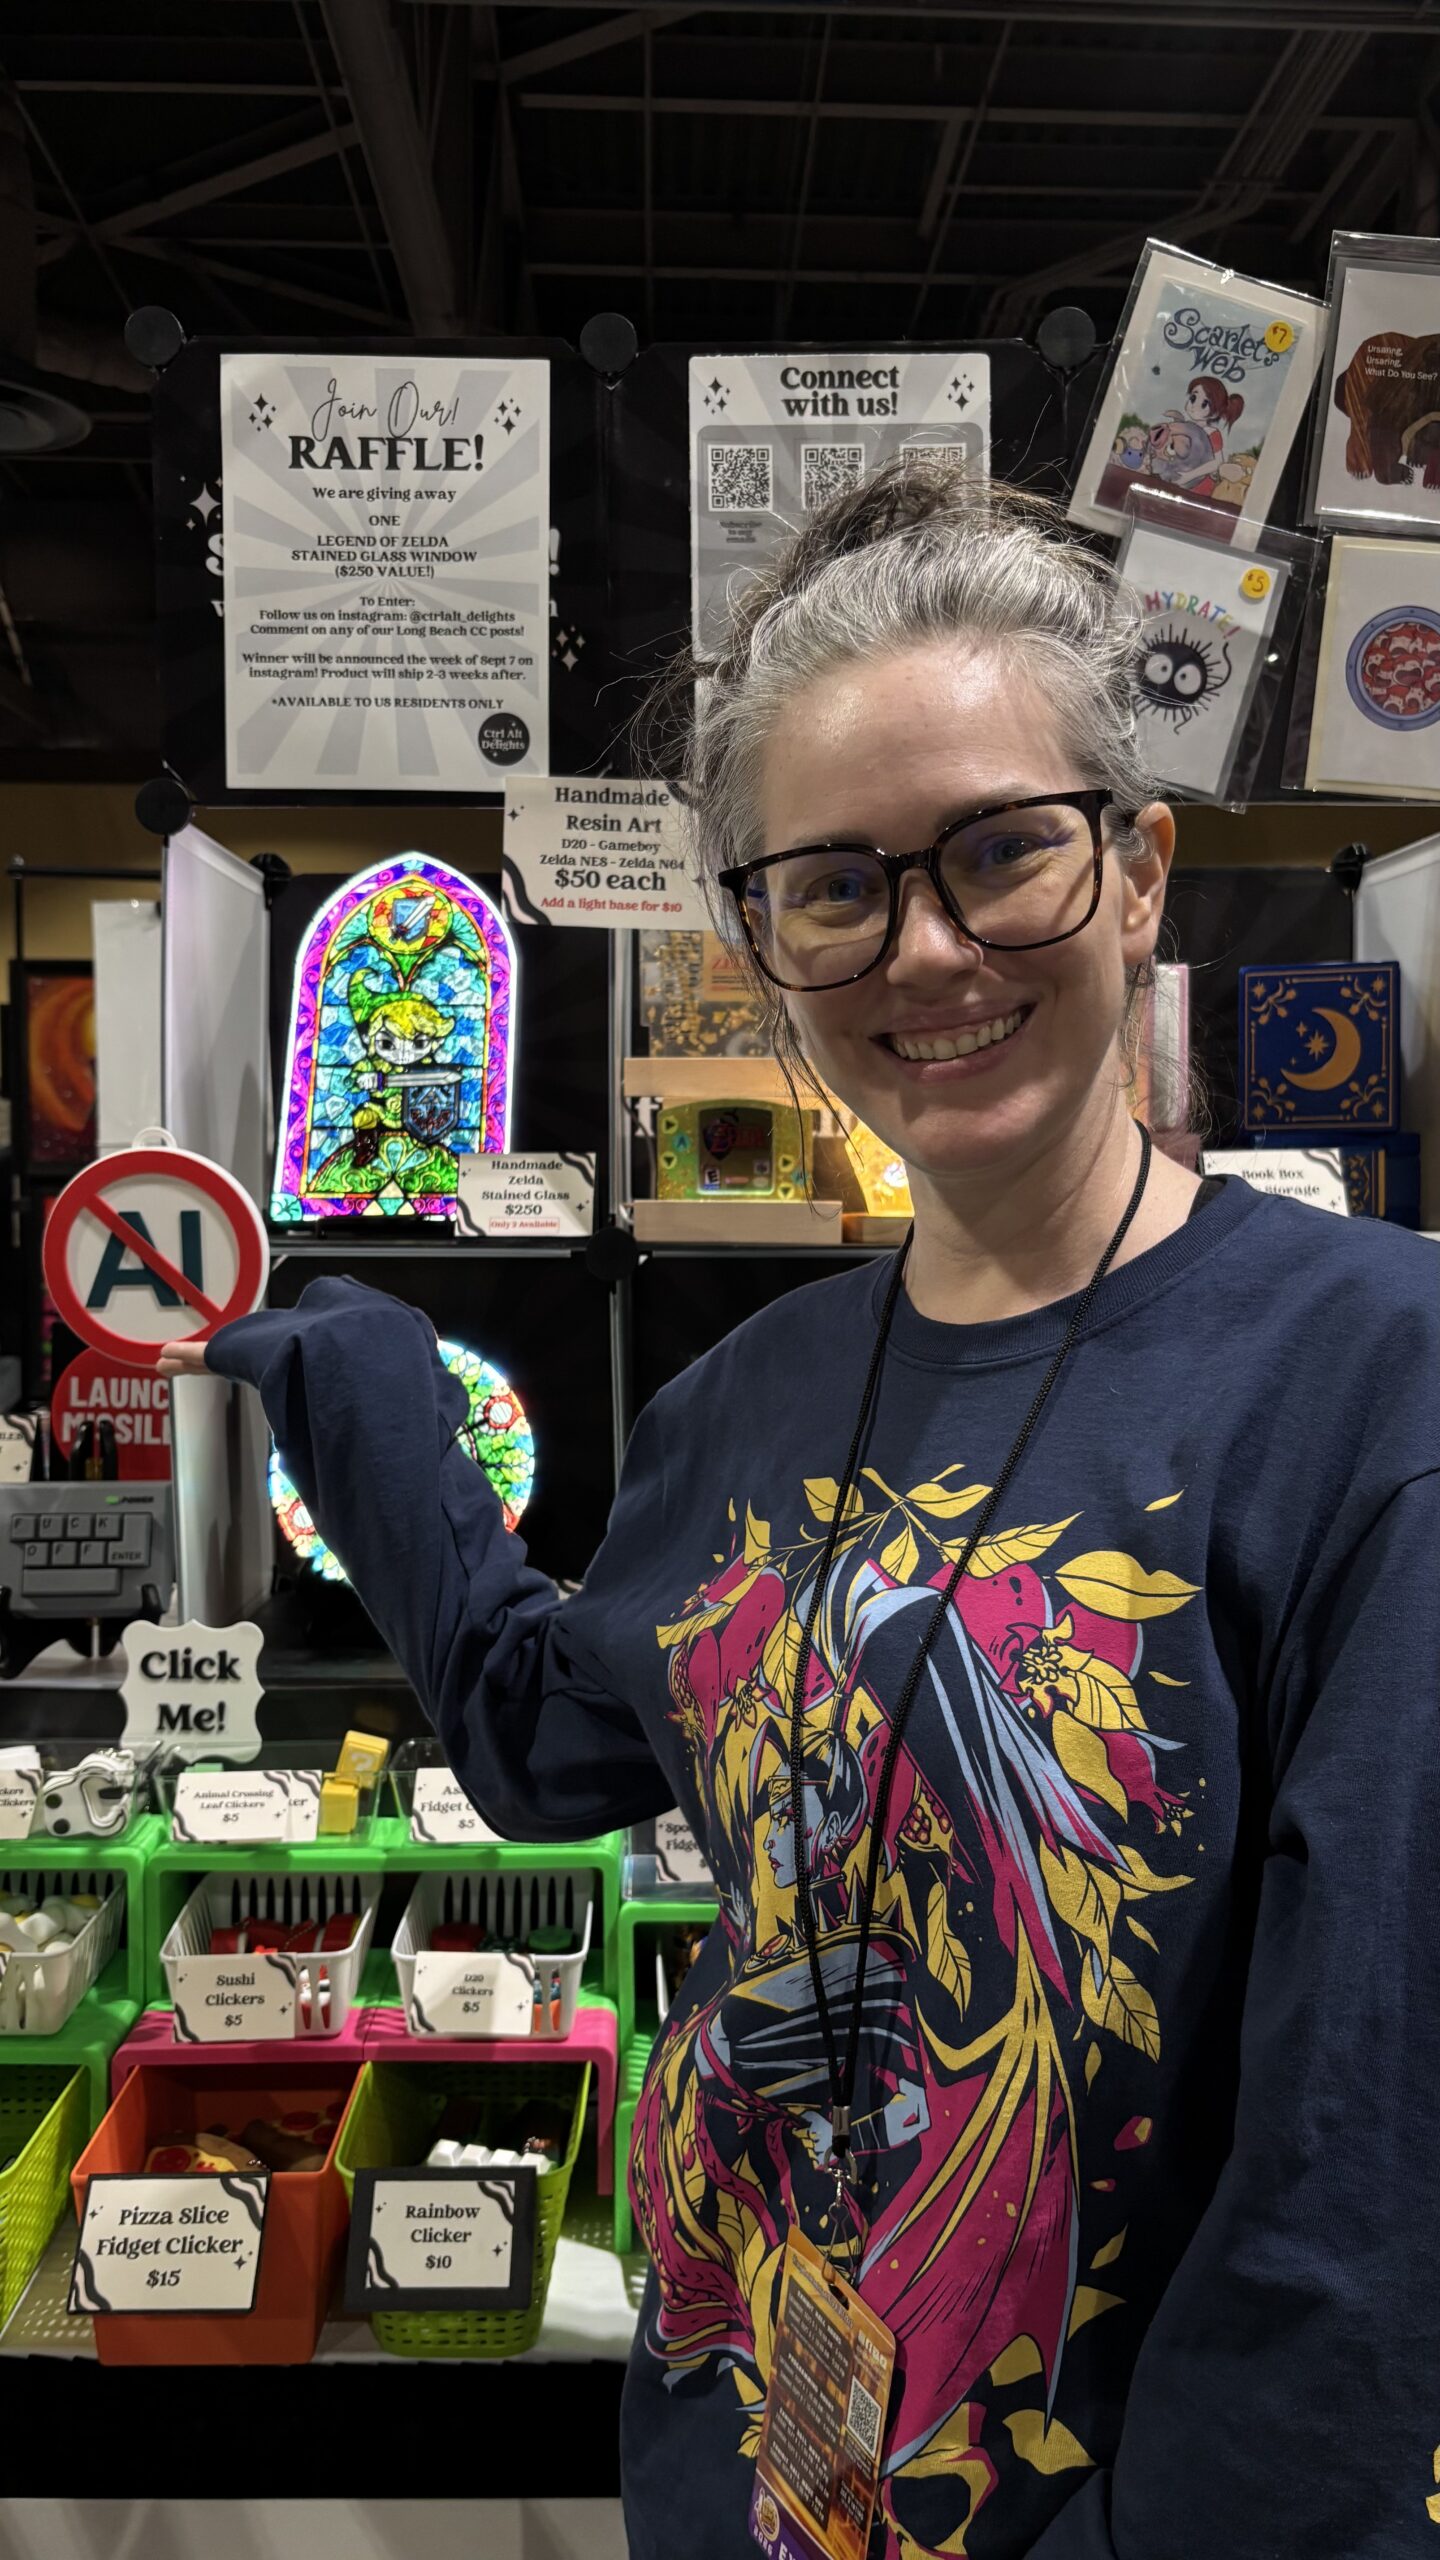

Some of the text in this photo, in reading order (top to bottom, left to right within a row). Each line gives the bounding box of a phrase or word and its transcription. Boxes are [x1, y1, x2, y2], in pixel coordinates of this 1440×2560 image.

[1189, 345, 1246, 383] Web
[780, 366, 900, 390] Connect
[1364, 367, 1438, 380] What Do You See?
[311, 378, 460, 442] Join Our!
[781, 391, 899, 417] with us!
[288, 433, 486, 472] RAFFLE!
[312, 486, 457, 503] We are giving away
[368, 515, 401, 527] ONE
[316, 535, 449, 548] LEGEND OF ZELDA
[291, 550, 478, 563] STAINED GLASS WINDOW
[335, 565, 435, 579] ($250 VALUE!)
[359, 596, 416, 607] To Enter:
[259, 609, 516, 624] Follow us on instagram: @ctrlalt_delights
[1144, 590, 1241, 641] HYDRATE!
[250, 624, 525, 640] Comment on any of our Long Beach CC posts!
[242, 653, 534, 669] Winner will be announced the week of Sept 7 on
[248, 667, 527, 683] instagram! Product will ship 2-3 weeks after.
[354, 697, 372, 708] TO
[373, 697, 392, 708] US
[393, 698, 467, 709] RESIDENTS
[468, 699, 504, 710] ONLY
[483, 728, 523, 739] Ctrl Alt
[481, 739, 525, 751] Delights
[554, 787, 670, 807] Handmade
[566, 813, 662, 834] Resin Art
[561, 838, 587, 850] D20
[598, 839, 661, 855] Gameboy
[539, 854, 576, 866] Zelda
[579, 855, 608, 868] NES
[618, 856, 656, 869] Zelda
[658, 858, 685, 871] N64
[554, 868, 667, 892] $50 each
[540, 897, 683, 913] Add a light base for $10
[491, 1160, 563, 1171] Handmade
[508, 1175, 544, 1186] Zelda
[707, 1169, 718, 1184] E
[1241, 1168, 1304, 1180] Book Box
[481, 1190, 570, 1201] Stained Glass
[504, 1203, 543, 1216] $250
[489, 1219, 511, 1230] Only
[519, 1220, 558, 1229] Available
[85, 1210, 204, 1308] AI
[111, 1551, 142, 1561] ENTER
[140, 1647, 242, 1681] Click
[156, 1701, 227, 1732] Me!
[193, 1789, 274, 1800] Animal Crossing
[199, 1800, 266, 1810] Leaf Clickers
[420, 1801, 462, 1814] Fidget
[222, 1813, 239, 1823] $5
[458, 1818, 476, 1829] $5
[215, 1972, 256, 1987] Sushi
[452, 1986, 494, 1996] Clickers
[205, 1991, 265, 2007] Clickers
[462, 2001, 481, 2013] $5
[224, 2013, 243, 2028] $5
[118, 2205, 230, 2227] Pizza Slice
[404, 2203, 481, 2221] Rainbow
[410, 2227, 472, 2244] Clicker
[95, 2235, 244, 2260] Fidget Clicker
[424, 2253, 453, 2271] $10
[145, 2268, 181, 2288] $15
